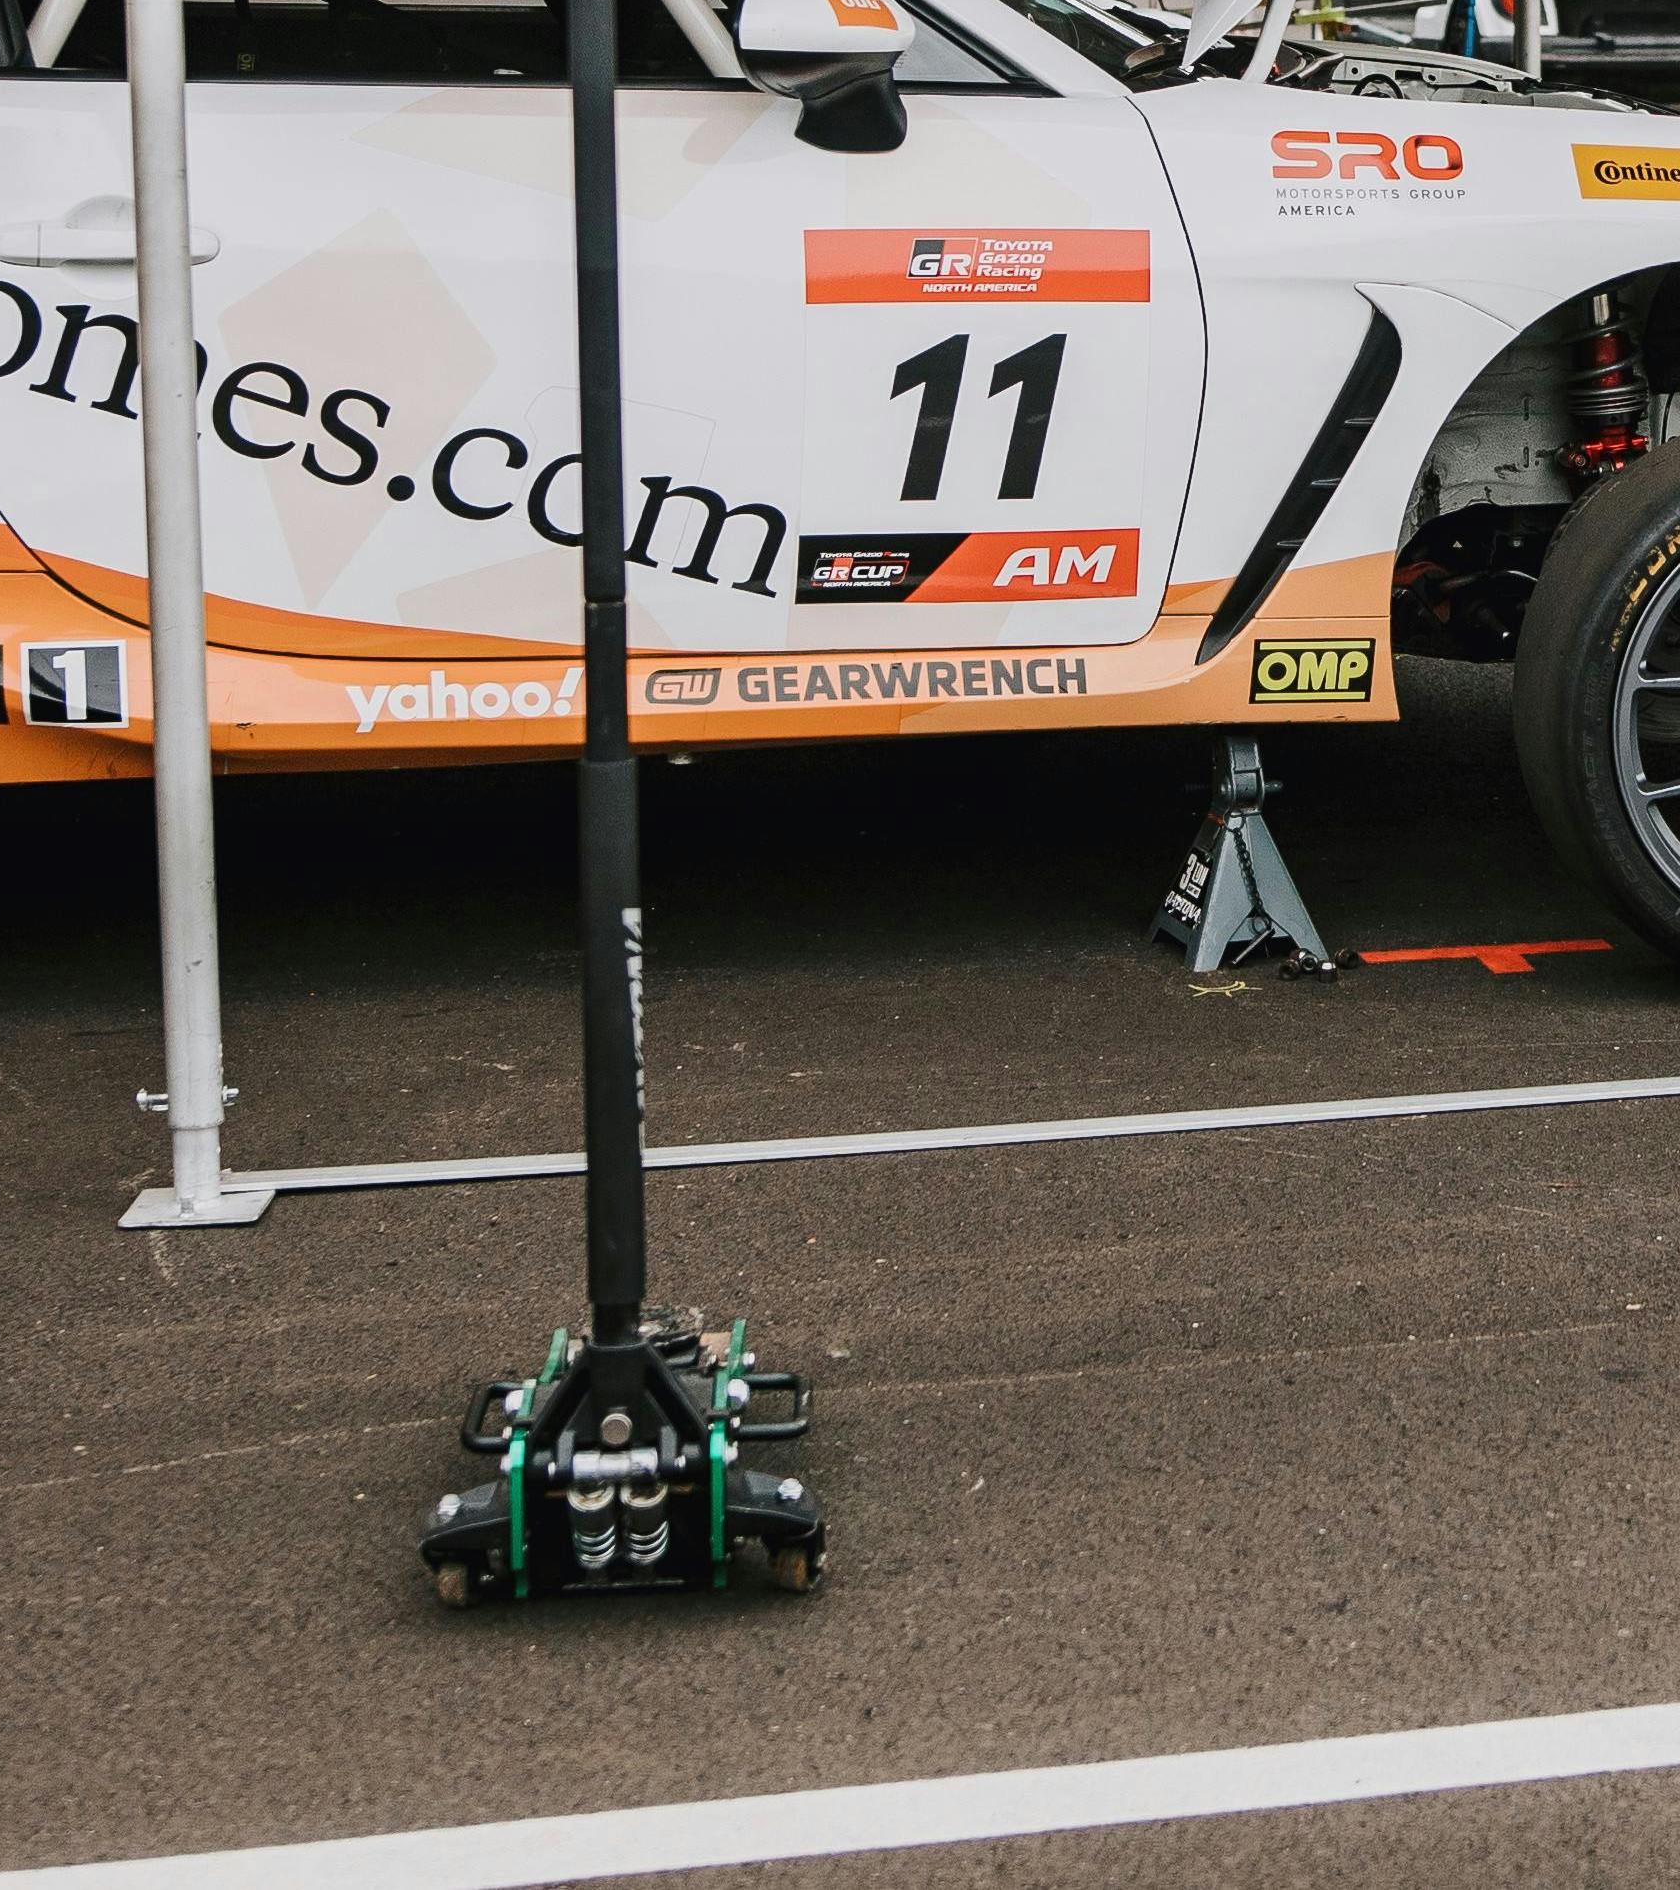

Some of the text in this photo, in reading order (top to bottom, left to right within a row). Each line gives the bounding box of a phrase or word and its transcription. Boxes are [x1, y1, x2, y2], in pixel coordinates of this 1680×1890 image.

[1271, 130, 1464, 181] SRO
[1275, 188, 1467, 200] MOTORSPORTS GROUP
[1278, 205, 1356, 216] AMERICA
[908, 253, 972, 279] GR
[976, 264, 1042, 280] Racing
[922, 283, 1038, 293] NORTH AMERICA
[889, 333, 1068, 502] 11
[813, 565, 904, 581] GR CUP
[993, 544, 1117, 586] AM
[737, 657, 1088, 704] GEARWRENCH
[1257, 648, 1368, 691] OMP
[345, 667, 583, 734] yahoo!
[650, 673, 716, 702] GW
[1179, 853, 1198, 890] 3
